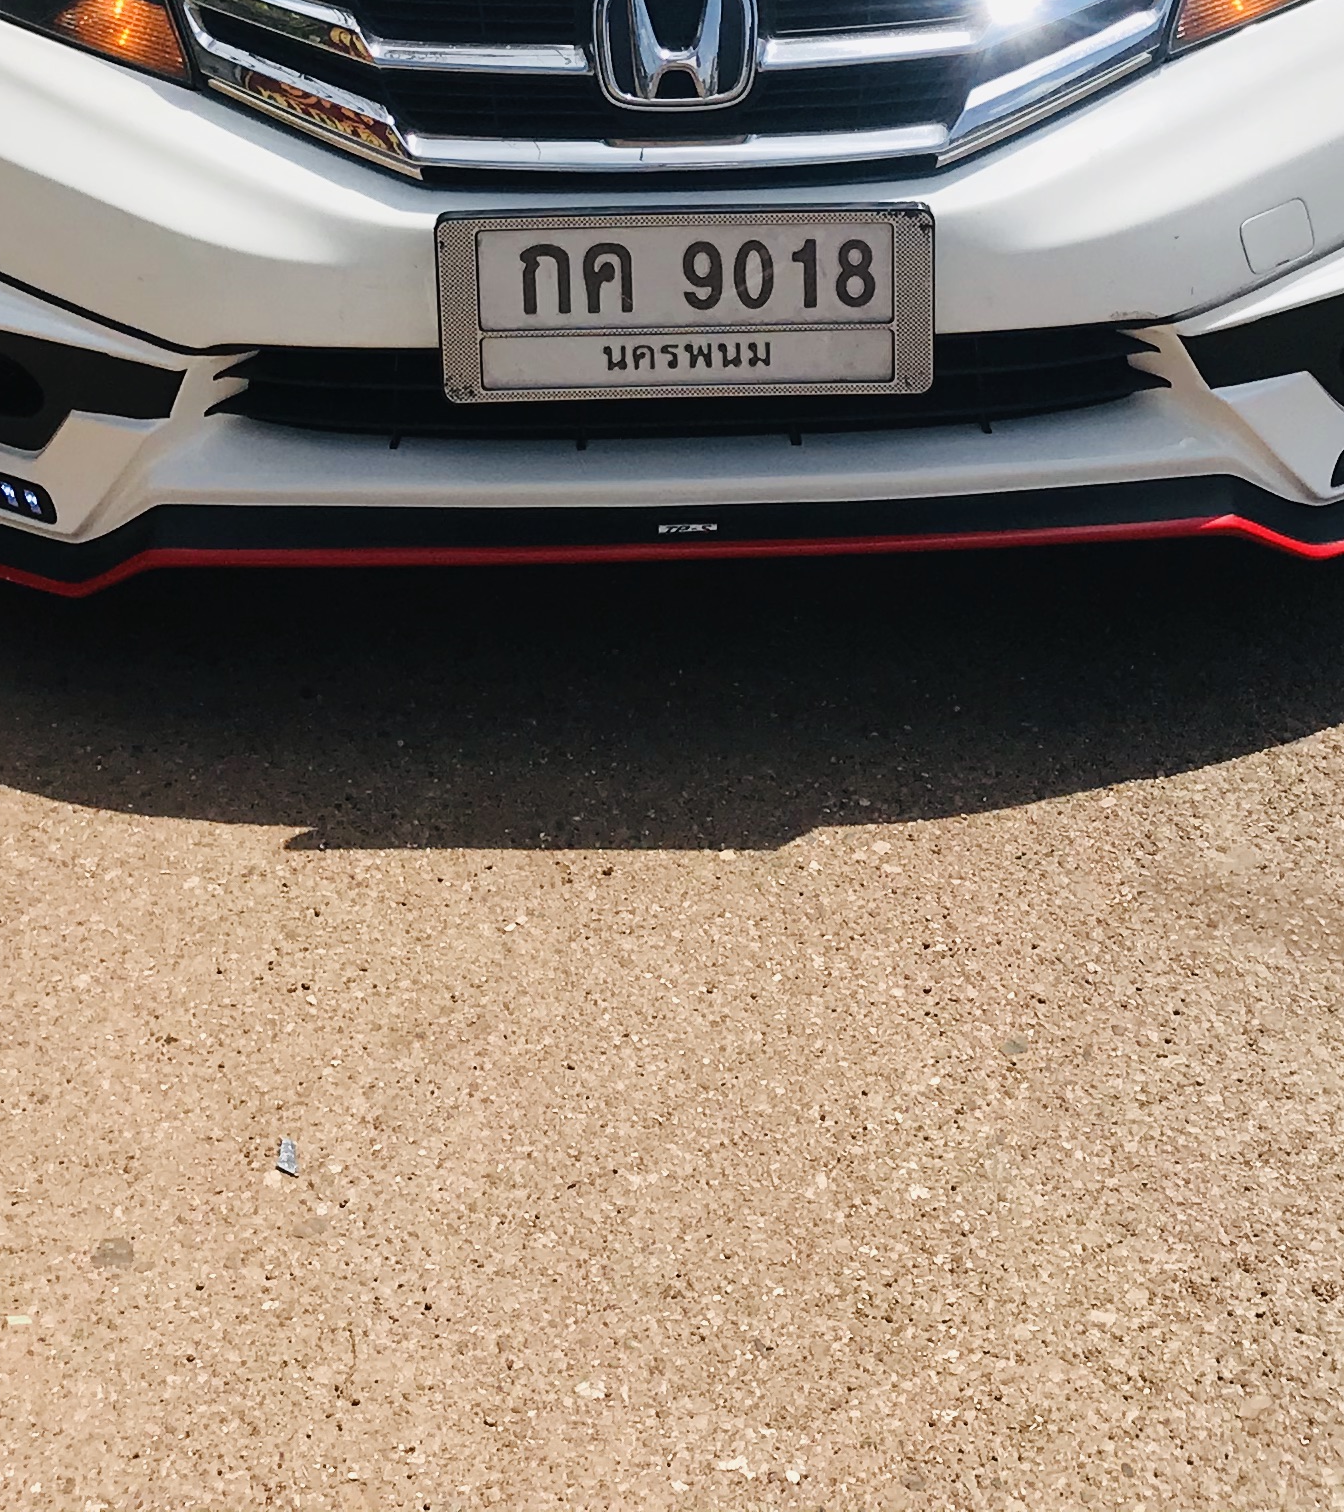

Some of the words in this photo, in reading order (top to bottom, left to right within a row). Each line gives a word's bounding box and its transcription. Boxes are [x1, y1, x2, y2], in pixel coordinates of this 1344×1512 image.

[519, 242, 634, 315] กค
[682, 238, 877, 310] 9018
[603, 340, 772, 371] นครพนม
